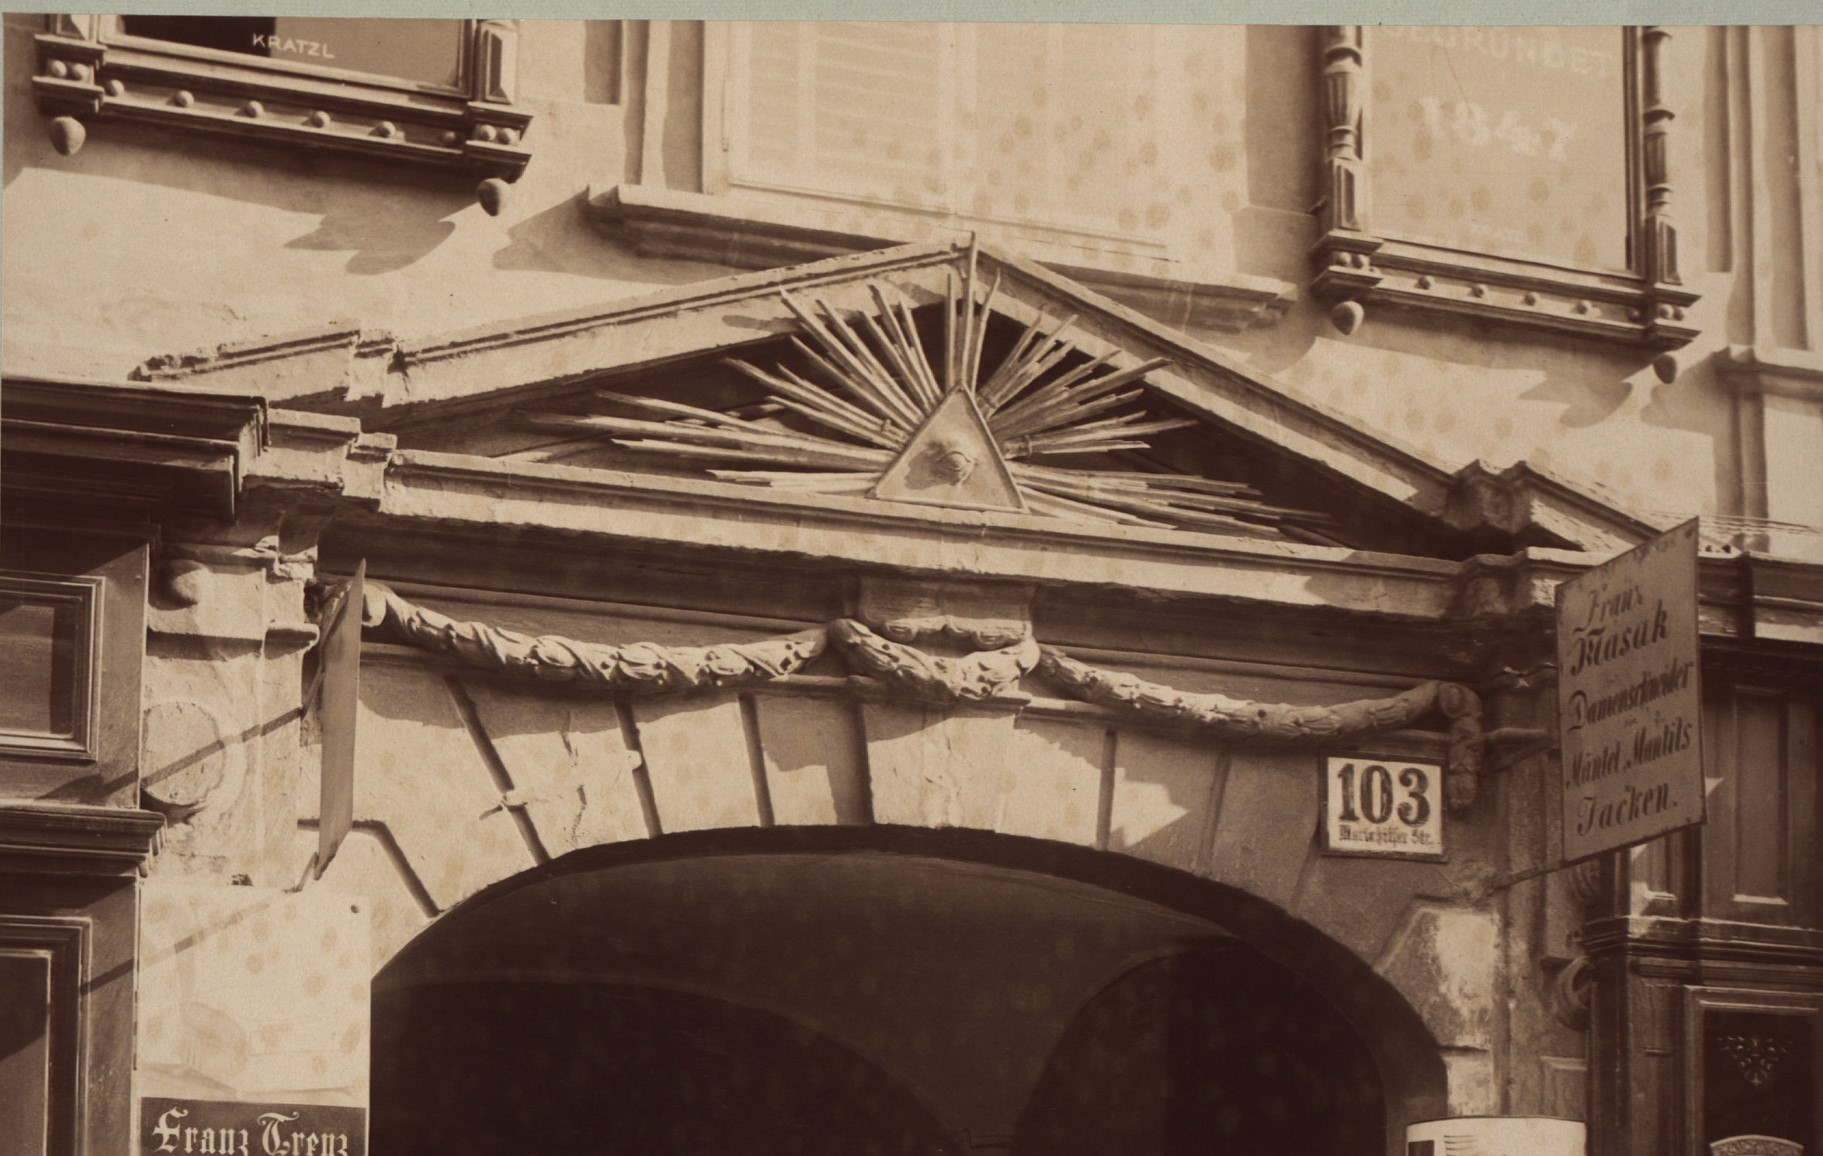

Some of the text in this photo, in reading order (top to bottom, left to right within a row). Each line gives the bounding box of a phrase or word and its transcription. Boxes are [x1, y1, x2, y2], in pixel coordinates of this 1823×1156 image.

[251, 32, 336, 59] KRATZL
[1573, 584, 1643, 633] Franz
[1567, 657, 1694, 735] Damenschneider
[1337, 763, 1431, 828] 103
